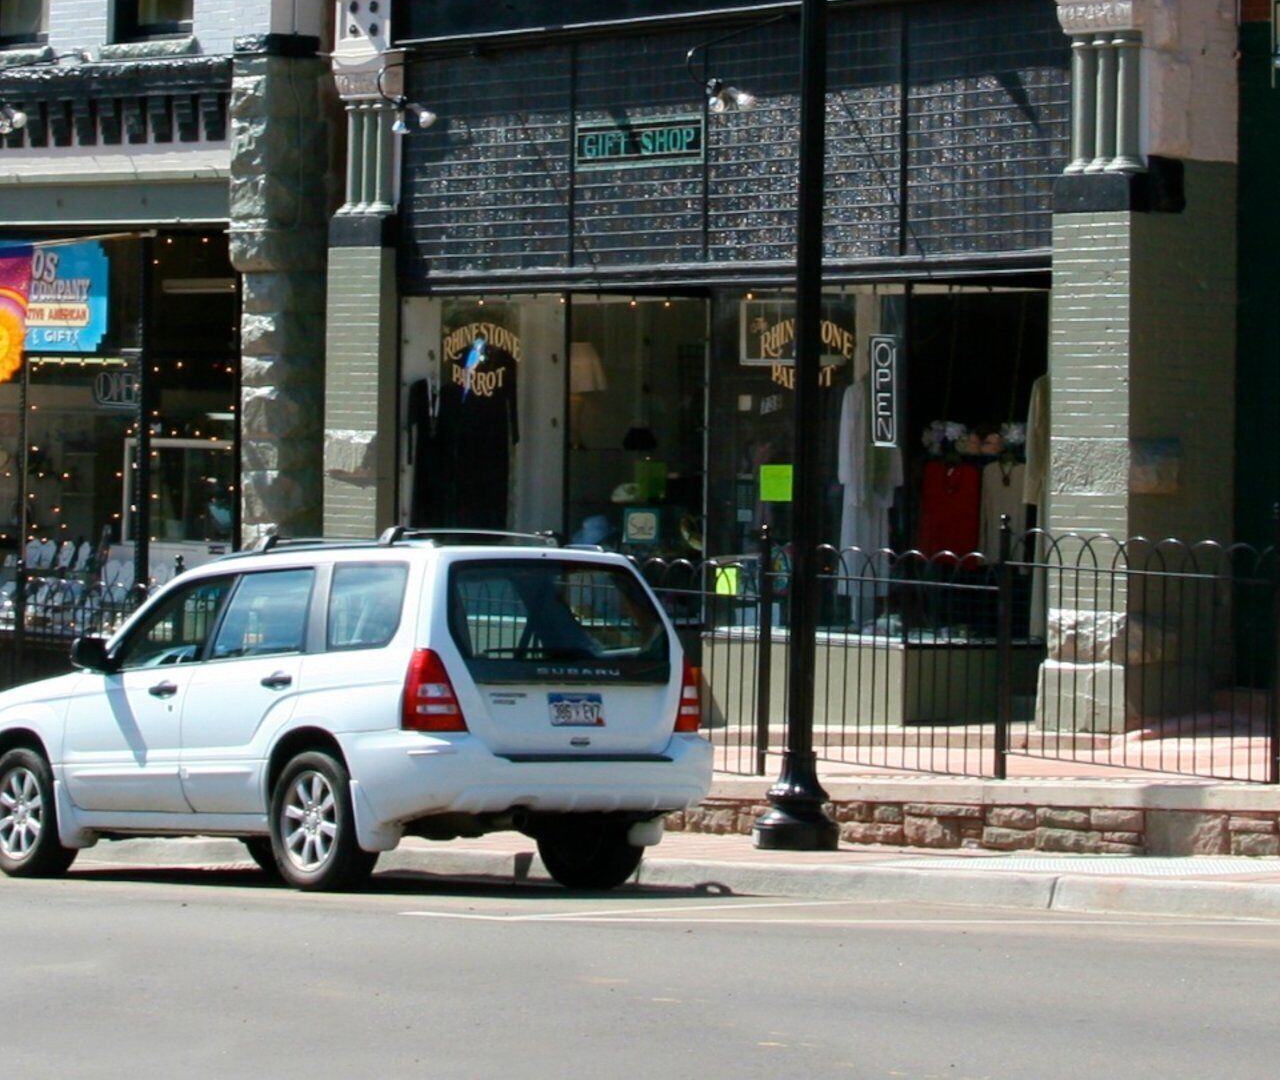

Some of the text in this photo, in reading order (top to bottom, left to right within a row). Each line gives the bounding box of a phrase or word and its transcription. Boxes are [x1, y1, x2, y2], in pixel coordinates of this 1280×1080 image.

[583, 127, 695, 160] GIFT SHOP
[32, 248, 59, 283] OS
[43, 329, 80, 345] GIFTS
[443, 322, 521, 362] RHINESTONE
[760, 317, 854, 360] RHINONE
[874, 342, 893, 441] OPEN
[536, 666, 620, 677] SUBARU
